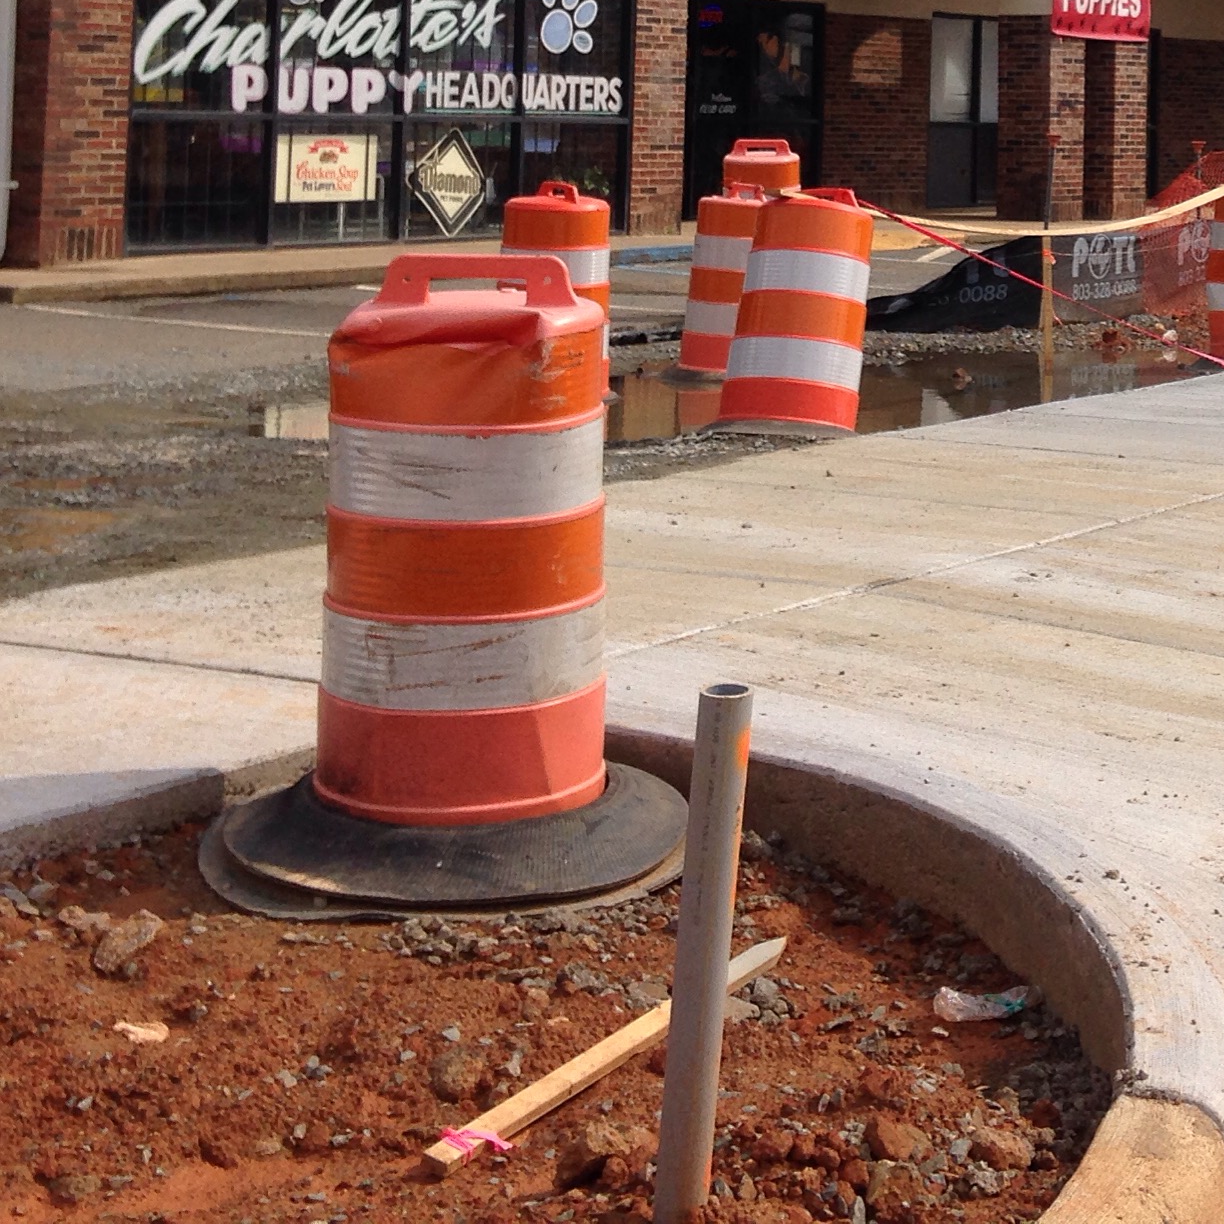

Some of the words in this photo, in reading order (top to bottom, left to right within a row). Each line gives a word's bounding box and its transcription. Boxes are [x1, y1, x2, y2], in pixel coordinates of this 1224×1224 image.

[231, 64, 425, 114] PUPPY
[425, 70, 623, 113] HEADQUARTERS
[296, 160, 336, 181] Chicken
[336, 165, 359, 182] Soup
[421, 167, 480, 195] Diamond
[1072, 279, 1137, 301] 803-328-0088
